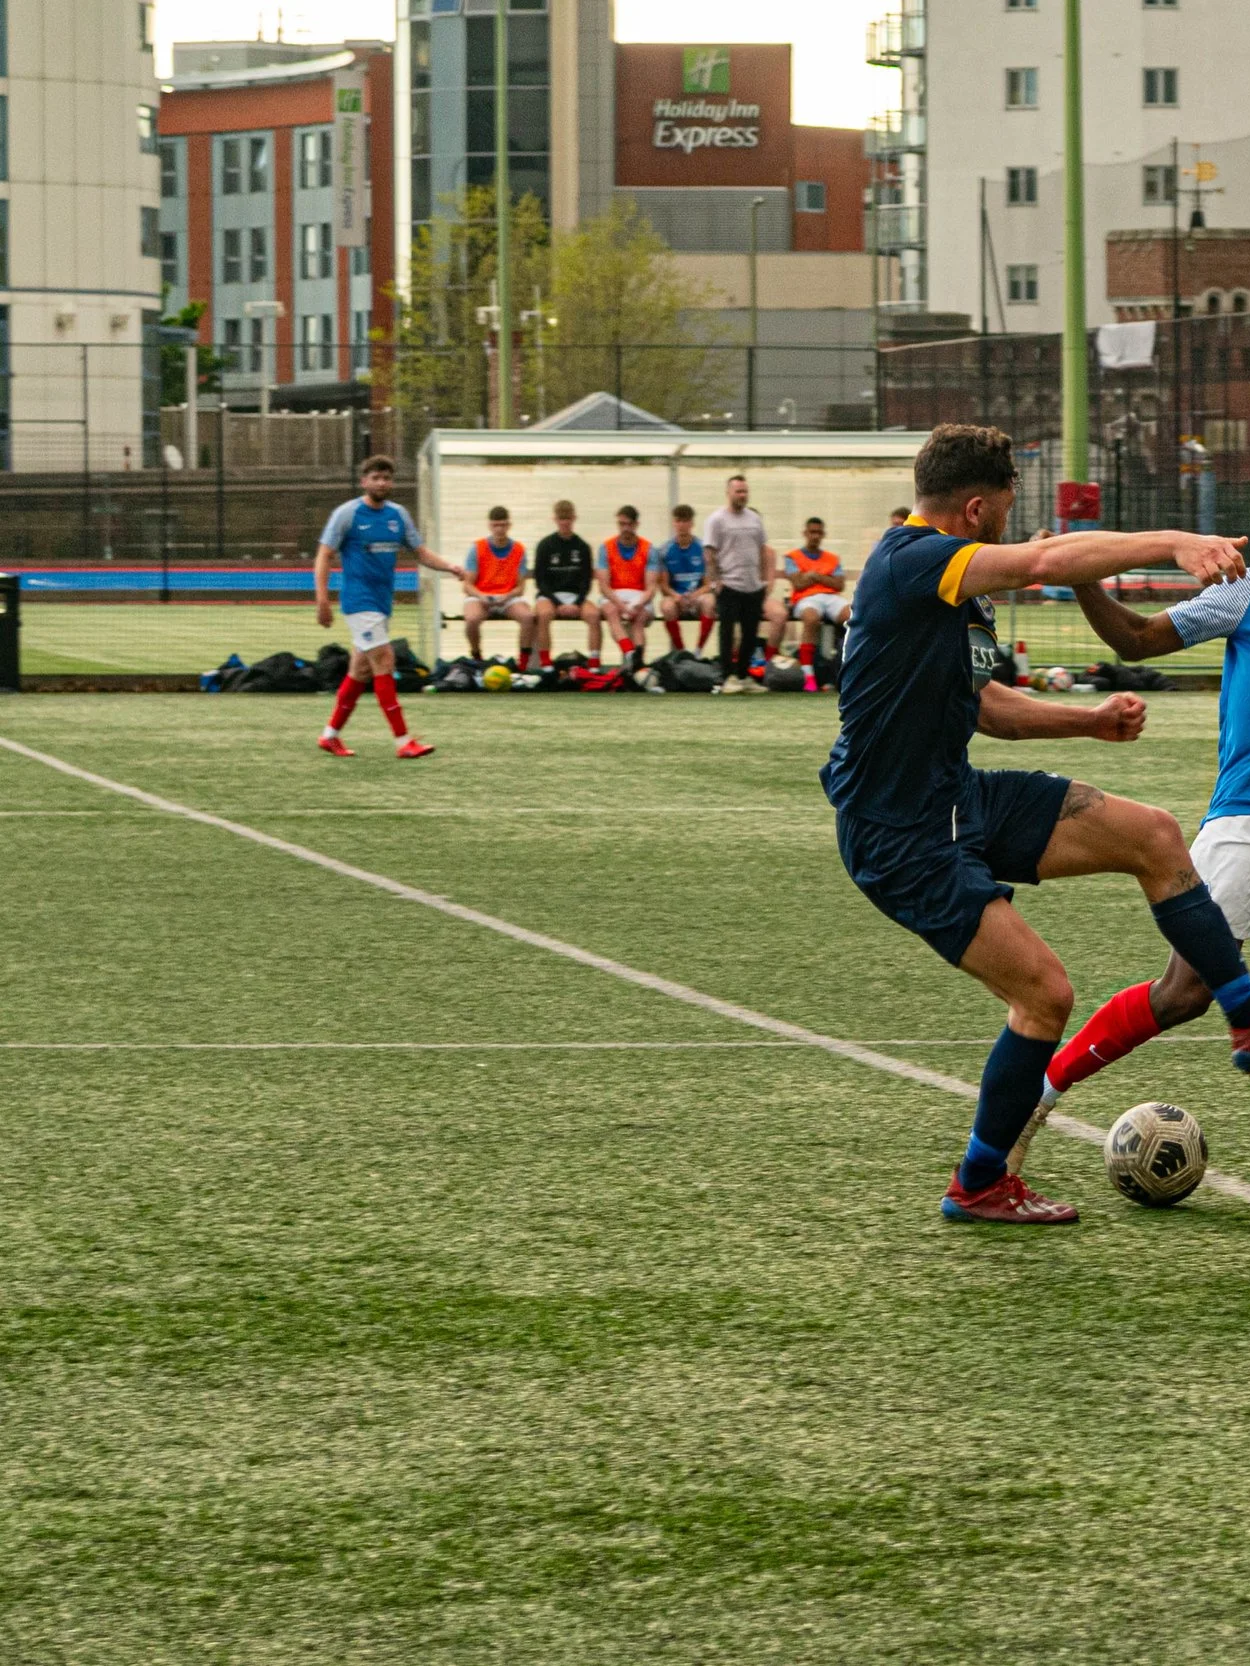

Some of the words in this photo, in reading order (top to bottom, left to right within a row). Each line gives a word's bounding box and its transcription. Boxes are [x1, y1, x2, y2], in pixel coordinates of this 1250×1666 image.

[654, 98, 727, 122] Holiday
[728, 98, 759, 117] Inn
[654, 121, 759, 153] Express
